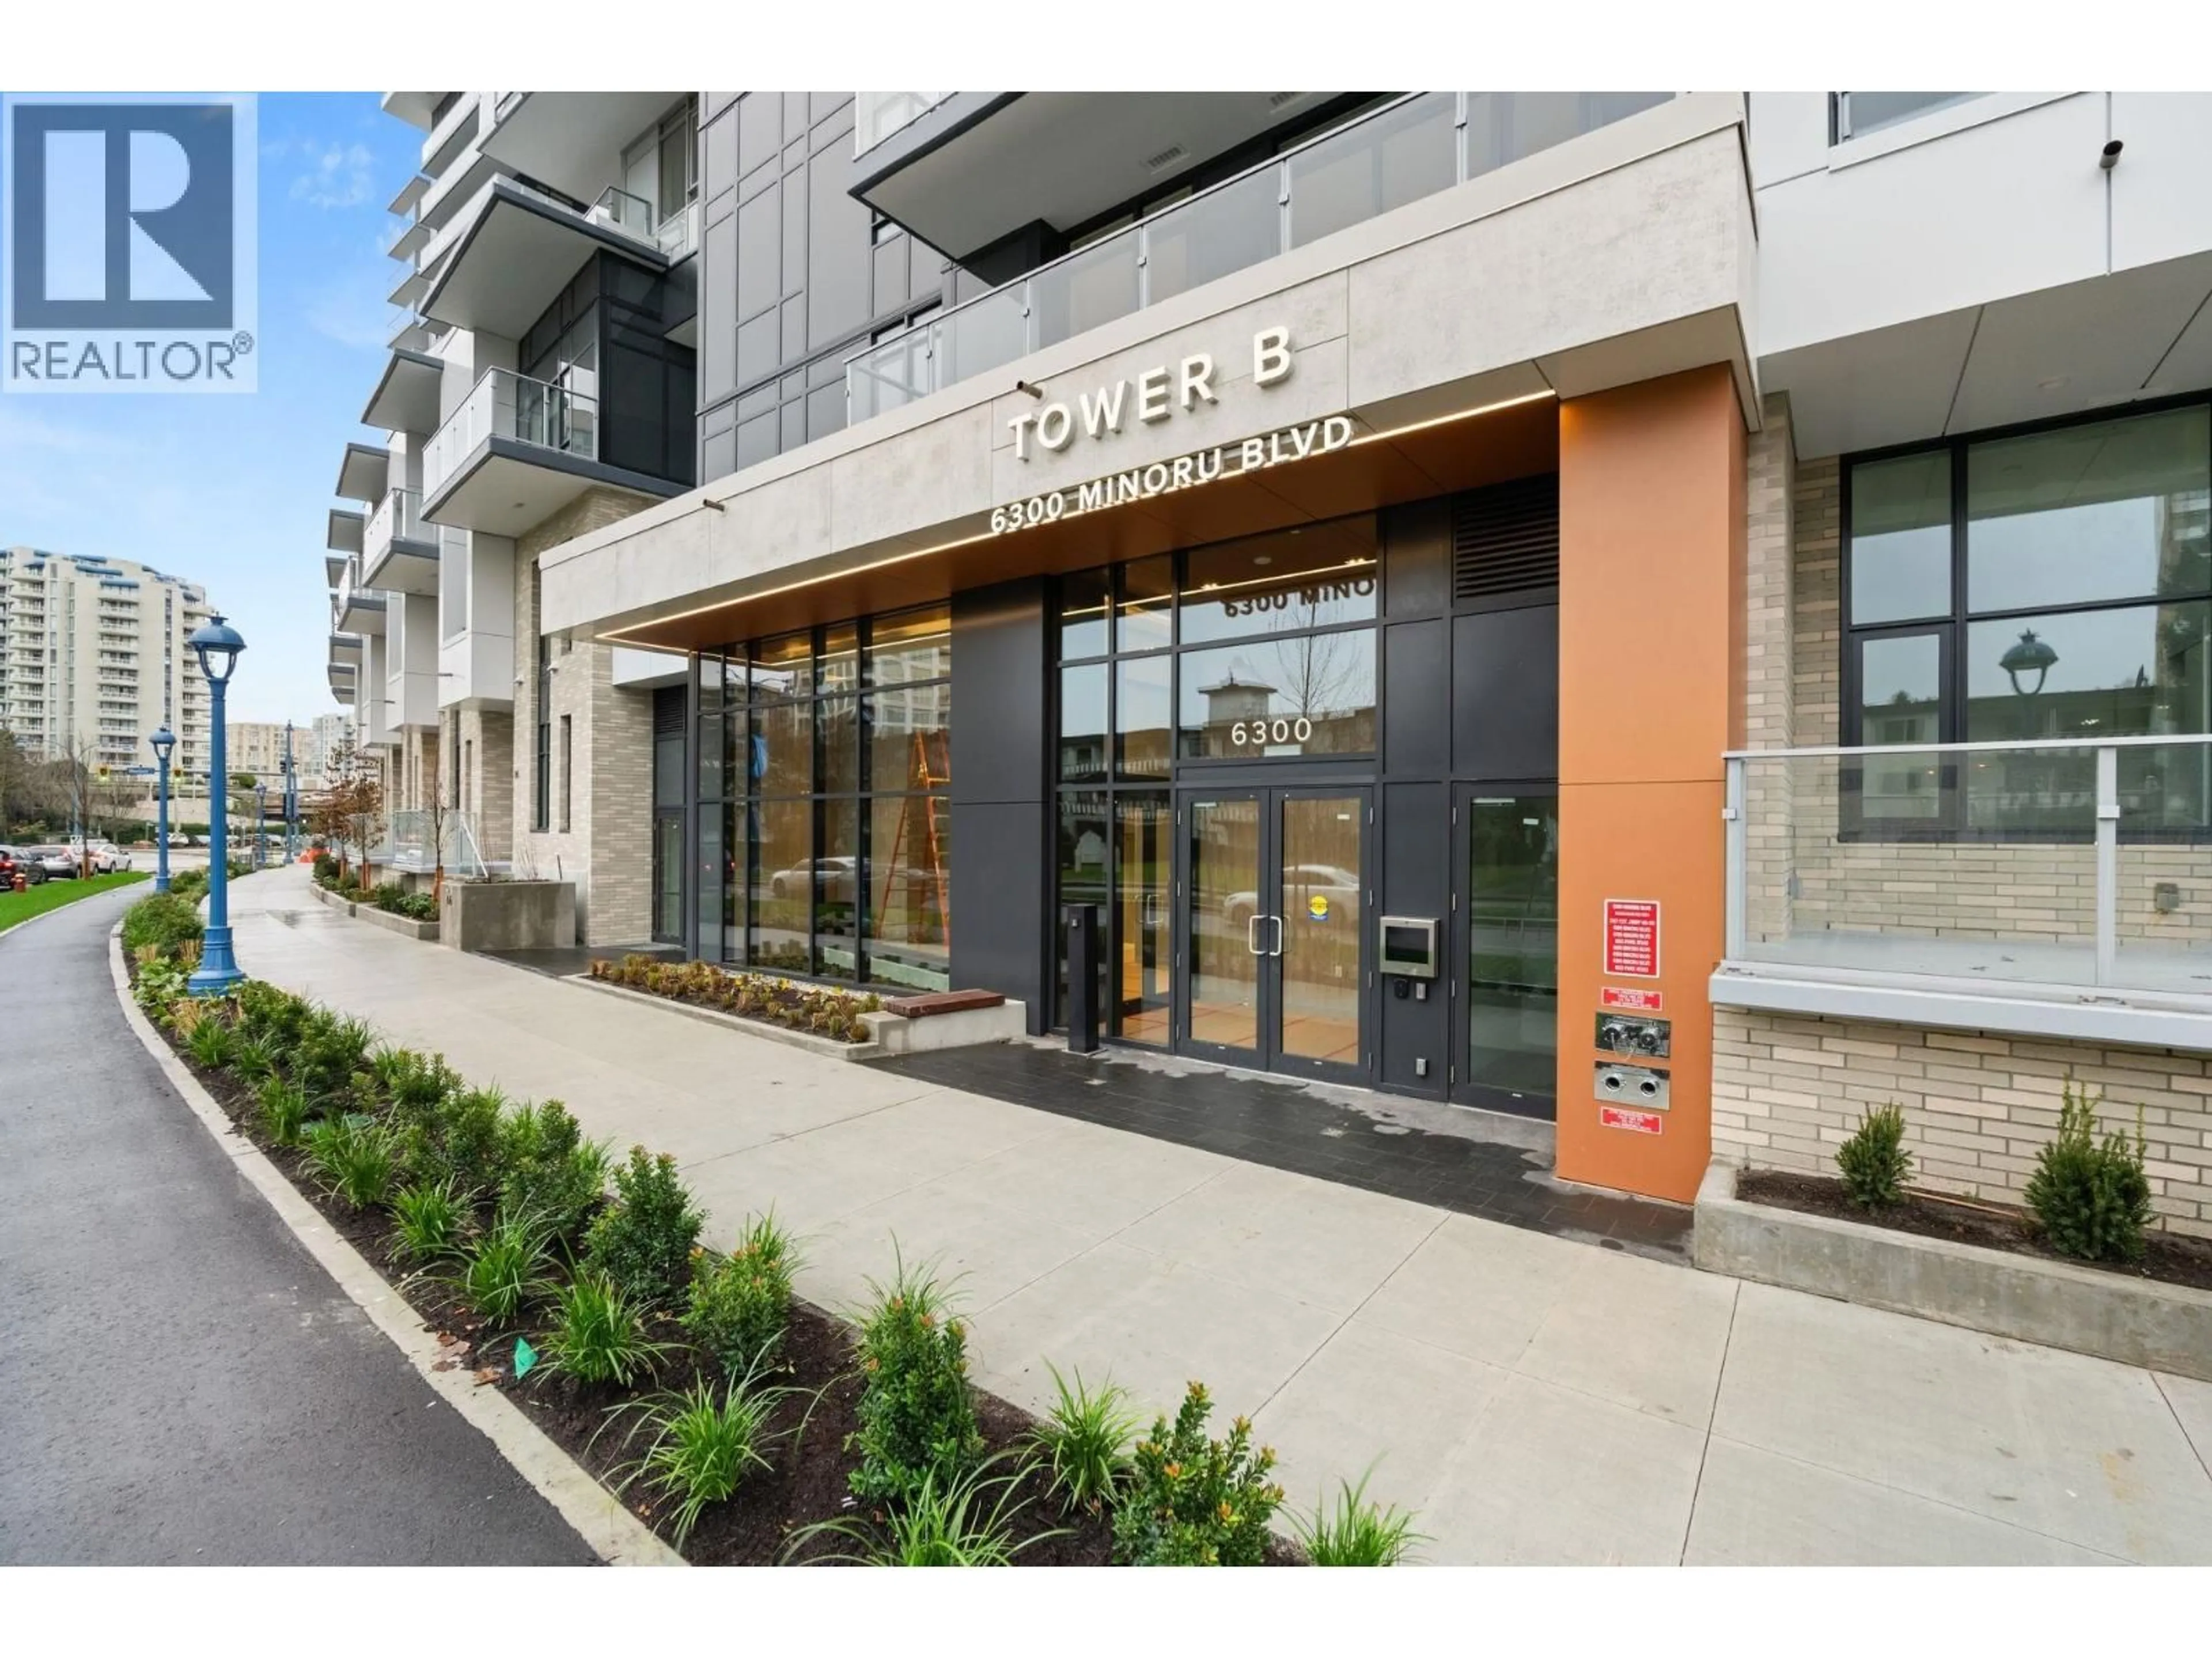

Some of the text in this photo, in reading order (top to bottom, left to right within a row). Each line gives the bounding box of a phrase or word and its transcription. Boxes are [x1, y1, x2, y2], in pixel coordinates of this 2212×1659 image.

[1007, 325, 1293, 461] TOWER B
[990, 416, 1352, 534] 6300 MINORU BLVD
[1231, 717, 1312, 746] 6300
